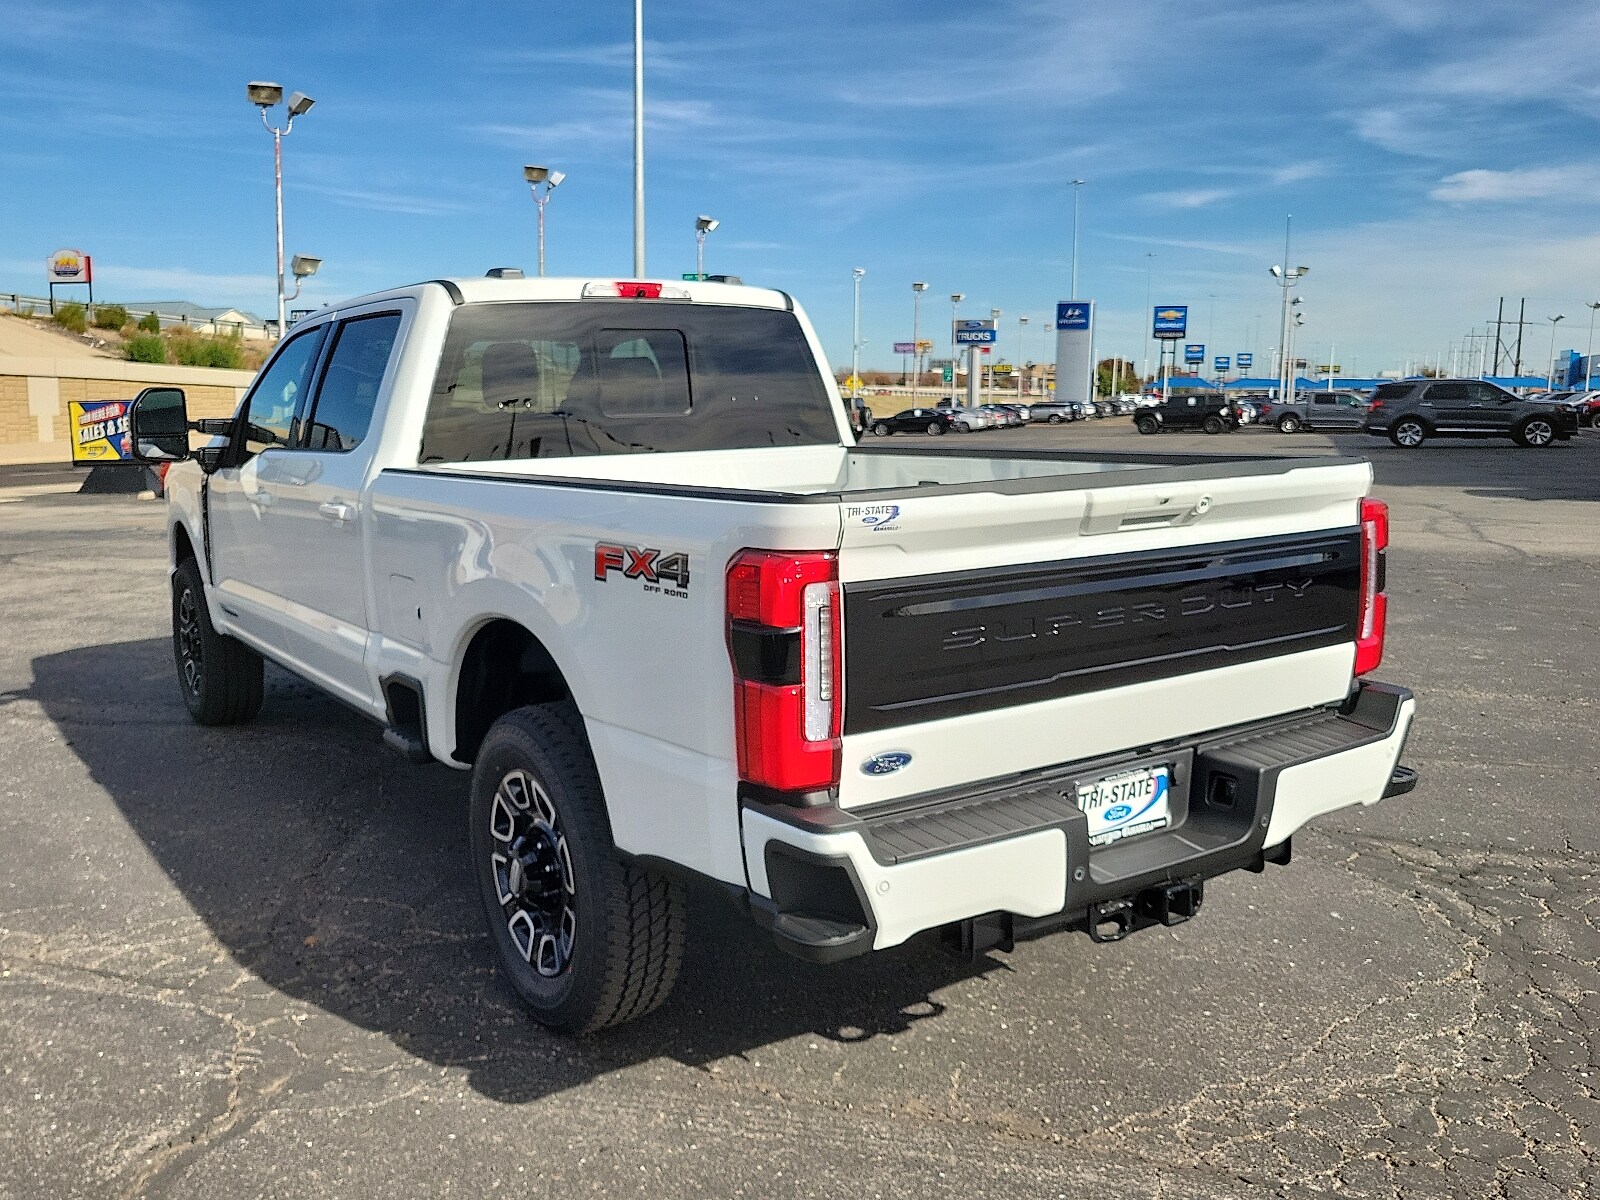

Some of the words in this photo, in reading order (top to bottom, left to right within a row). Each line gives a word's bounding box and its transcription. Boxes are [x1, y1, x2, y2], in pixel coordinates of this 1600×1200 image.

[957, 331, 992, 341] TRUCKS
[79, 422, 106, 444] SALES
[107, 419, 116, 436] &
[846, 505, 891, 518] TRI-STATE
[595, 541, 689, 589] FX4
[643, 584, 661, 594] OFF
[663, 587, 688, 599] ROAD
[942, 602, 1166, 651] SUPER
[1180, 578, 1313, 617] DUTY
[1079, 777, 1154, 812] TRI-STATE
